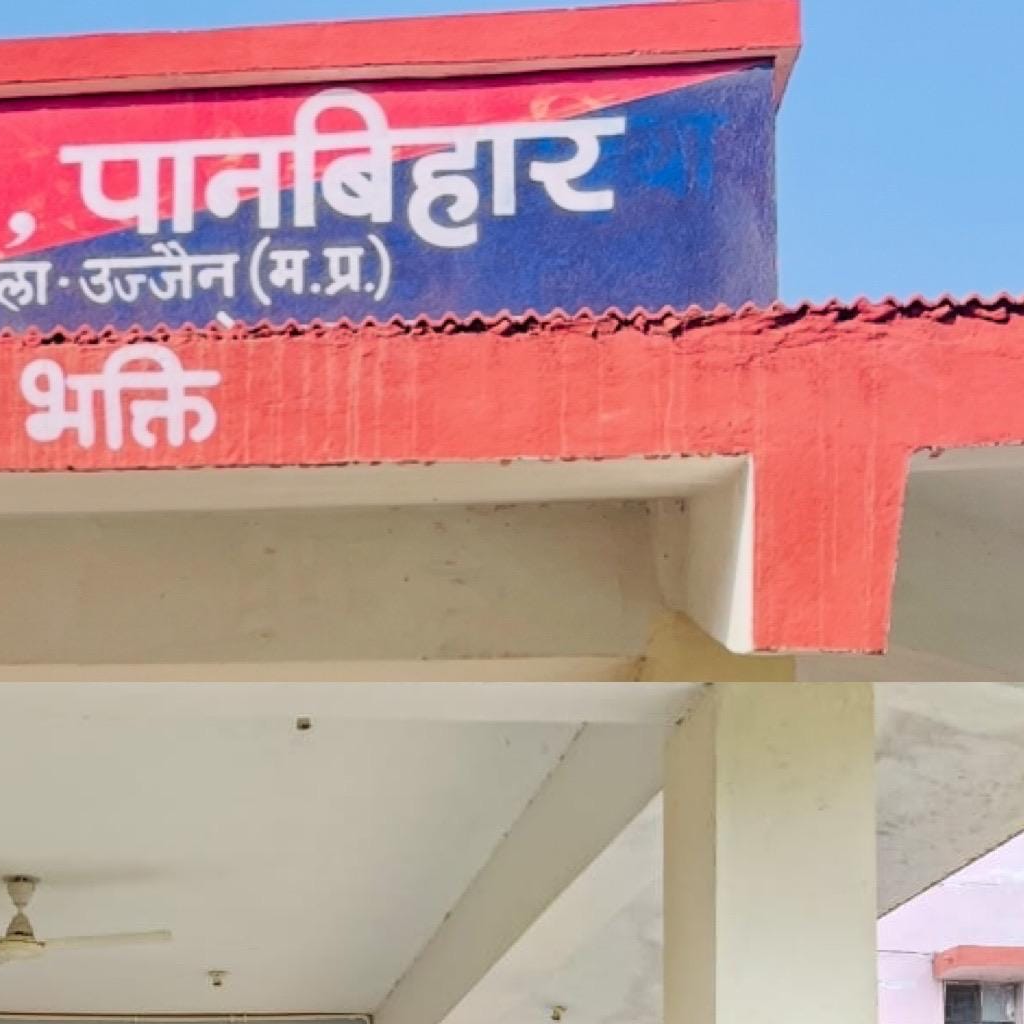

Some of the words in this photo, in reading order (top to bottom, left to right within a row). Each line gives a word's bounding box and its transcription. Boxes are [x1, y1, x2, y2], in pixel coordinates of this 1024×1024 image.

[59, 88, 626, 249] पानबिहार
[79, 241, 241, 302] उज्जैन
[19, 342, 221, 451] भक्ति
